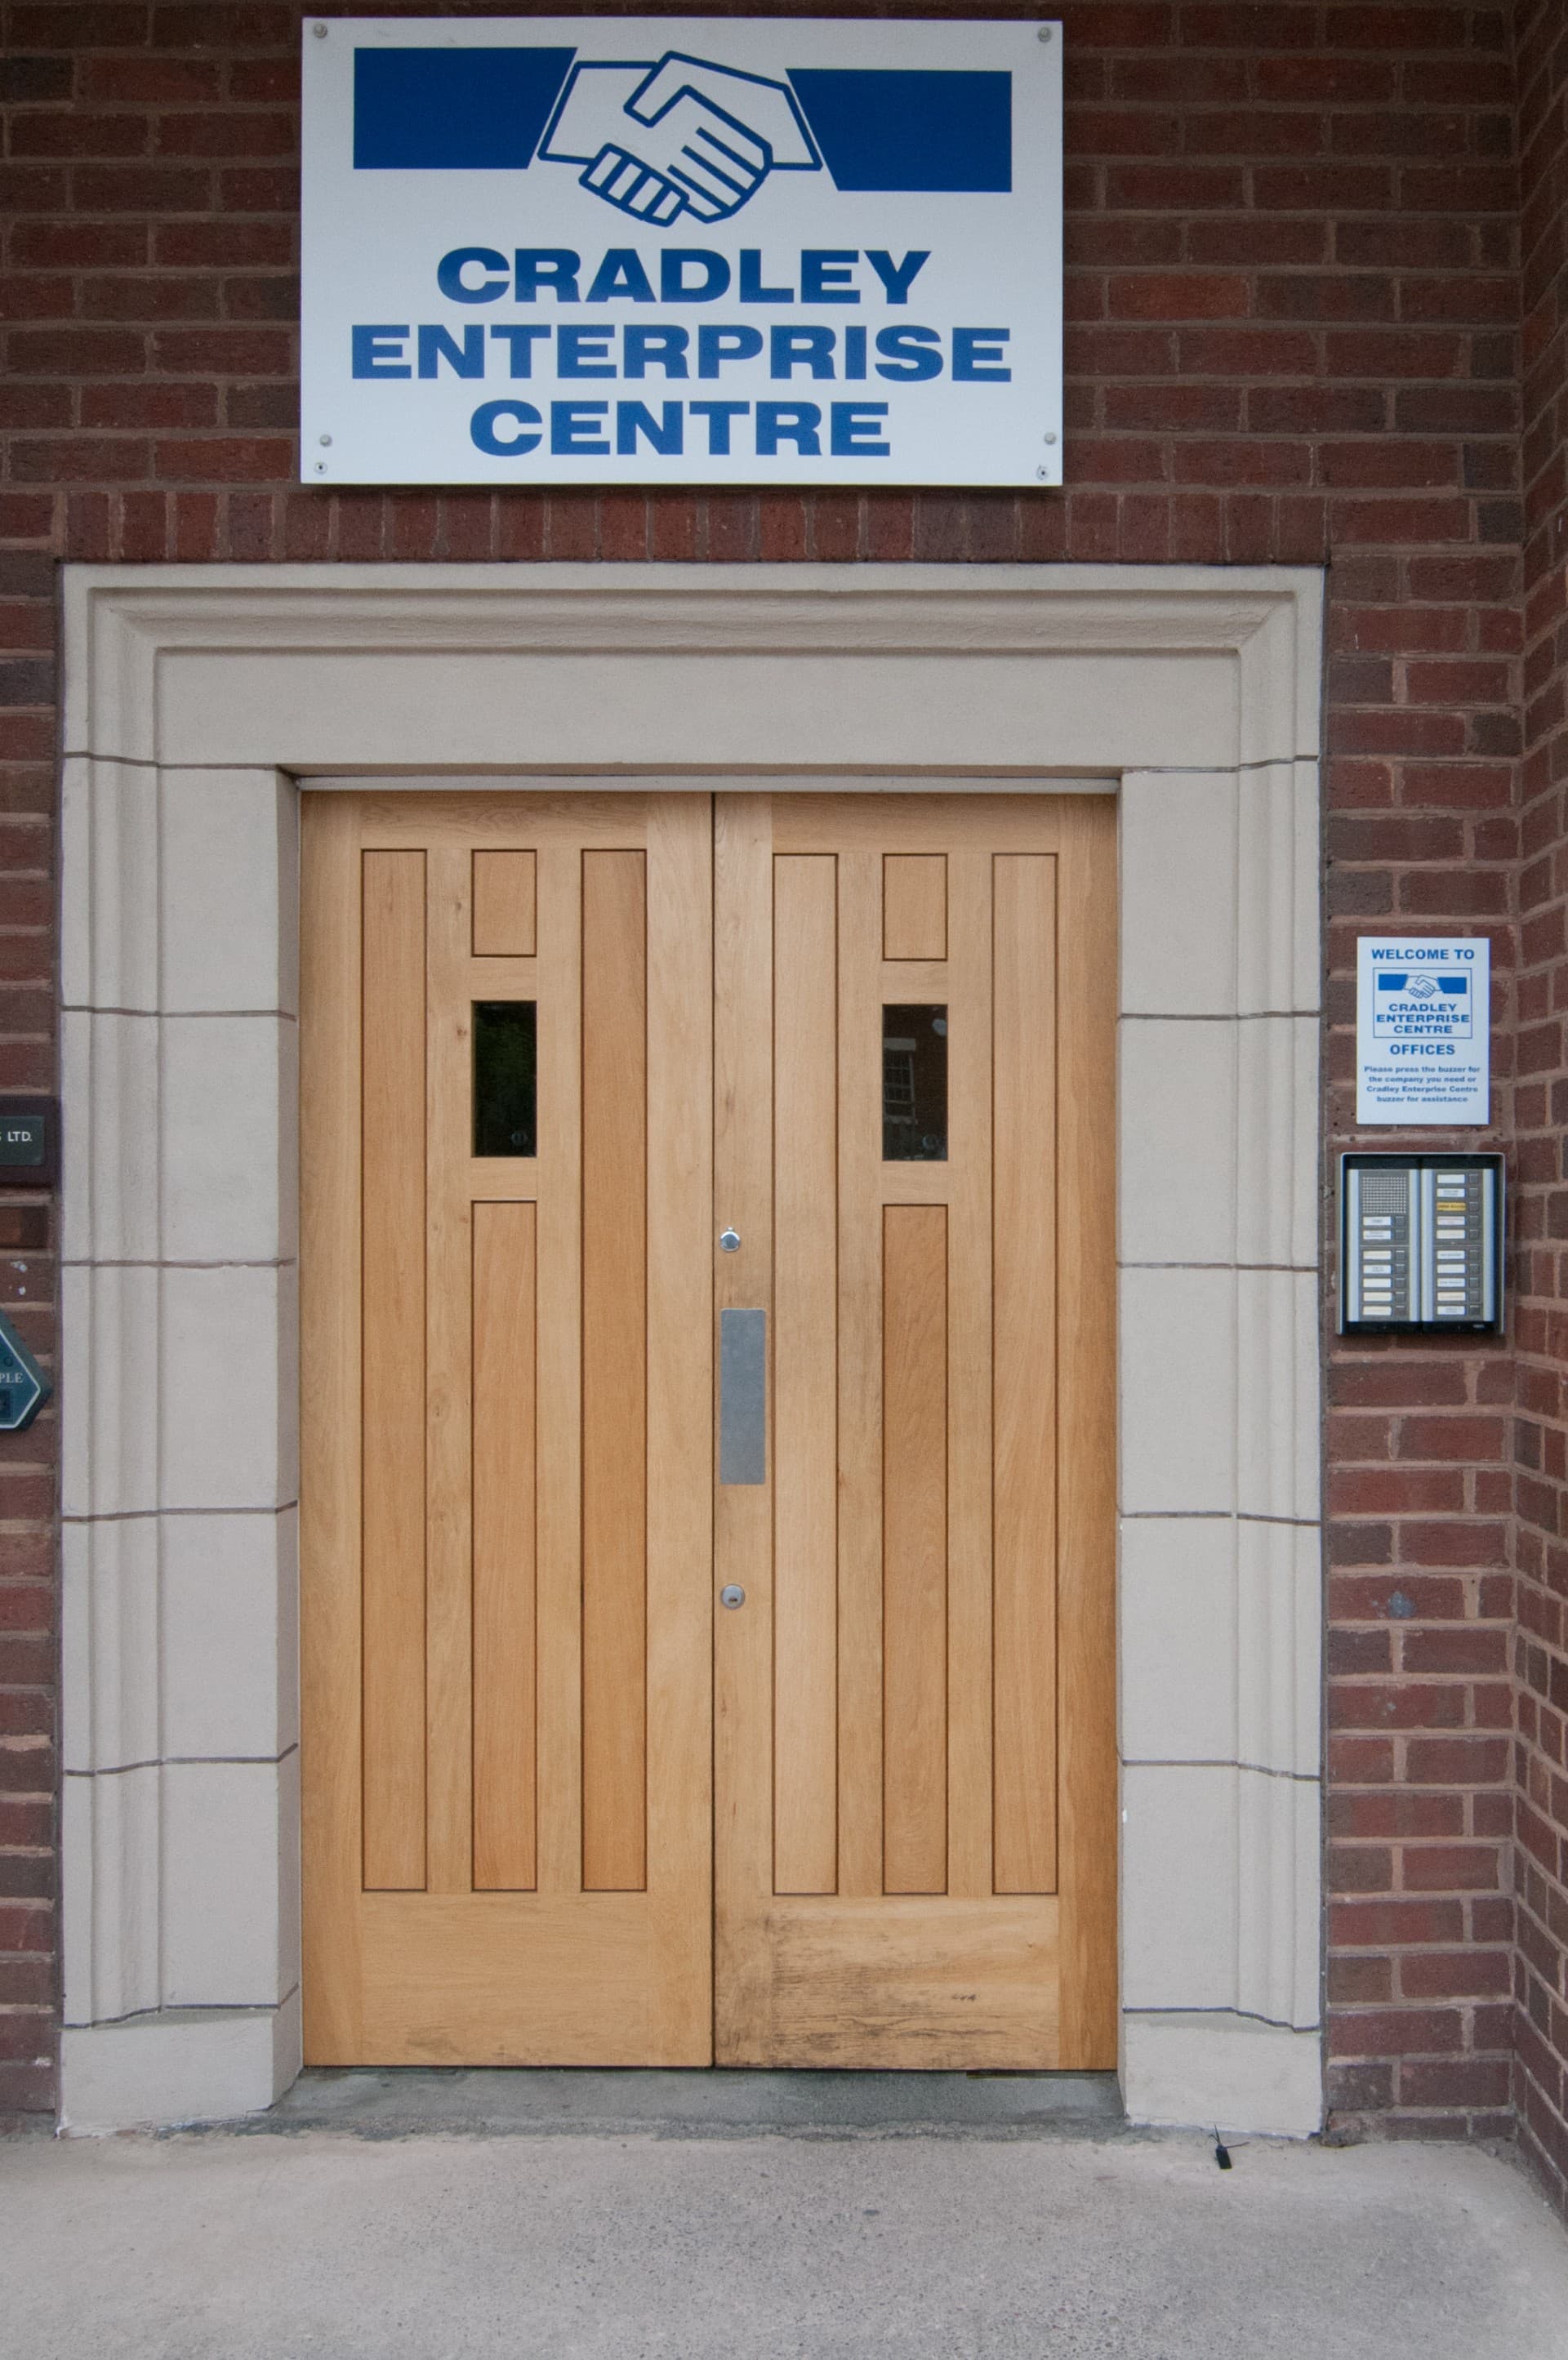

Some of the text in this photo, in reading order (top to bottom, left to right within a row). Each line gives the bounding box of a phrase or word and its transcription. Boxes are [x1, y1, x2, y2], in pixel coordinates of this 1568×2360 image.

[436, 247, 932, 305] CRADLEY
[351, 323, 1013, 382] ENTERPRISE
[470, 399, 891, 456] CENTRE
[1371, 949, 1475, 960] WELCOME TO
[1388, 1003, 1457, 1012] CRADLEY
[1376, 1014, 1470, 1022] ENTERPRISE
[1393, 1025, 1453, 1033] CENTRE
[1390, 1044, 1455, 1055] OFFICES
[1366, 1085, 1400, 1093] Cradley
[1402, 1085, 1447, 1093] Enterprise
